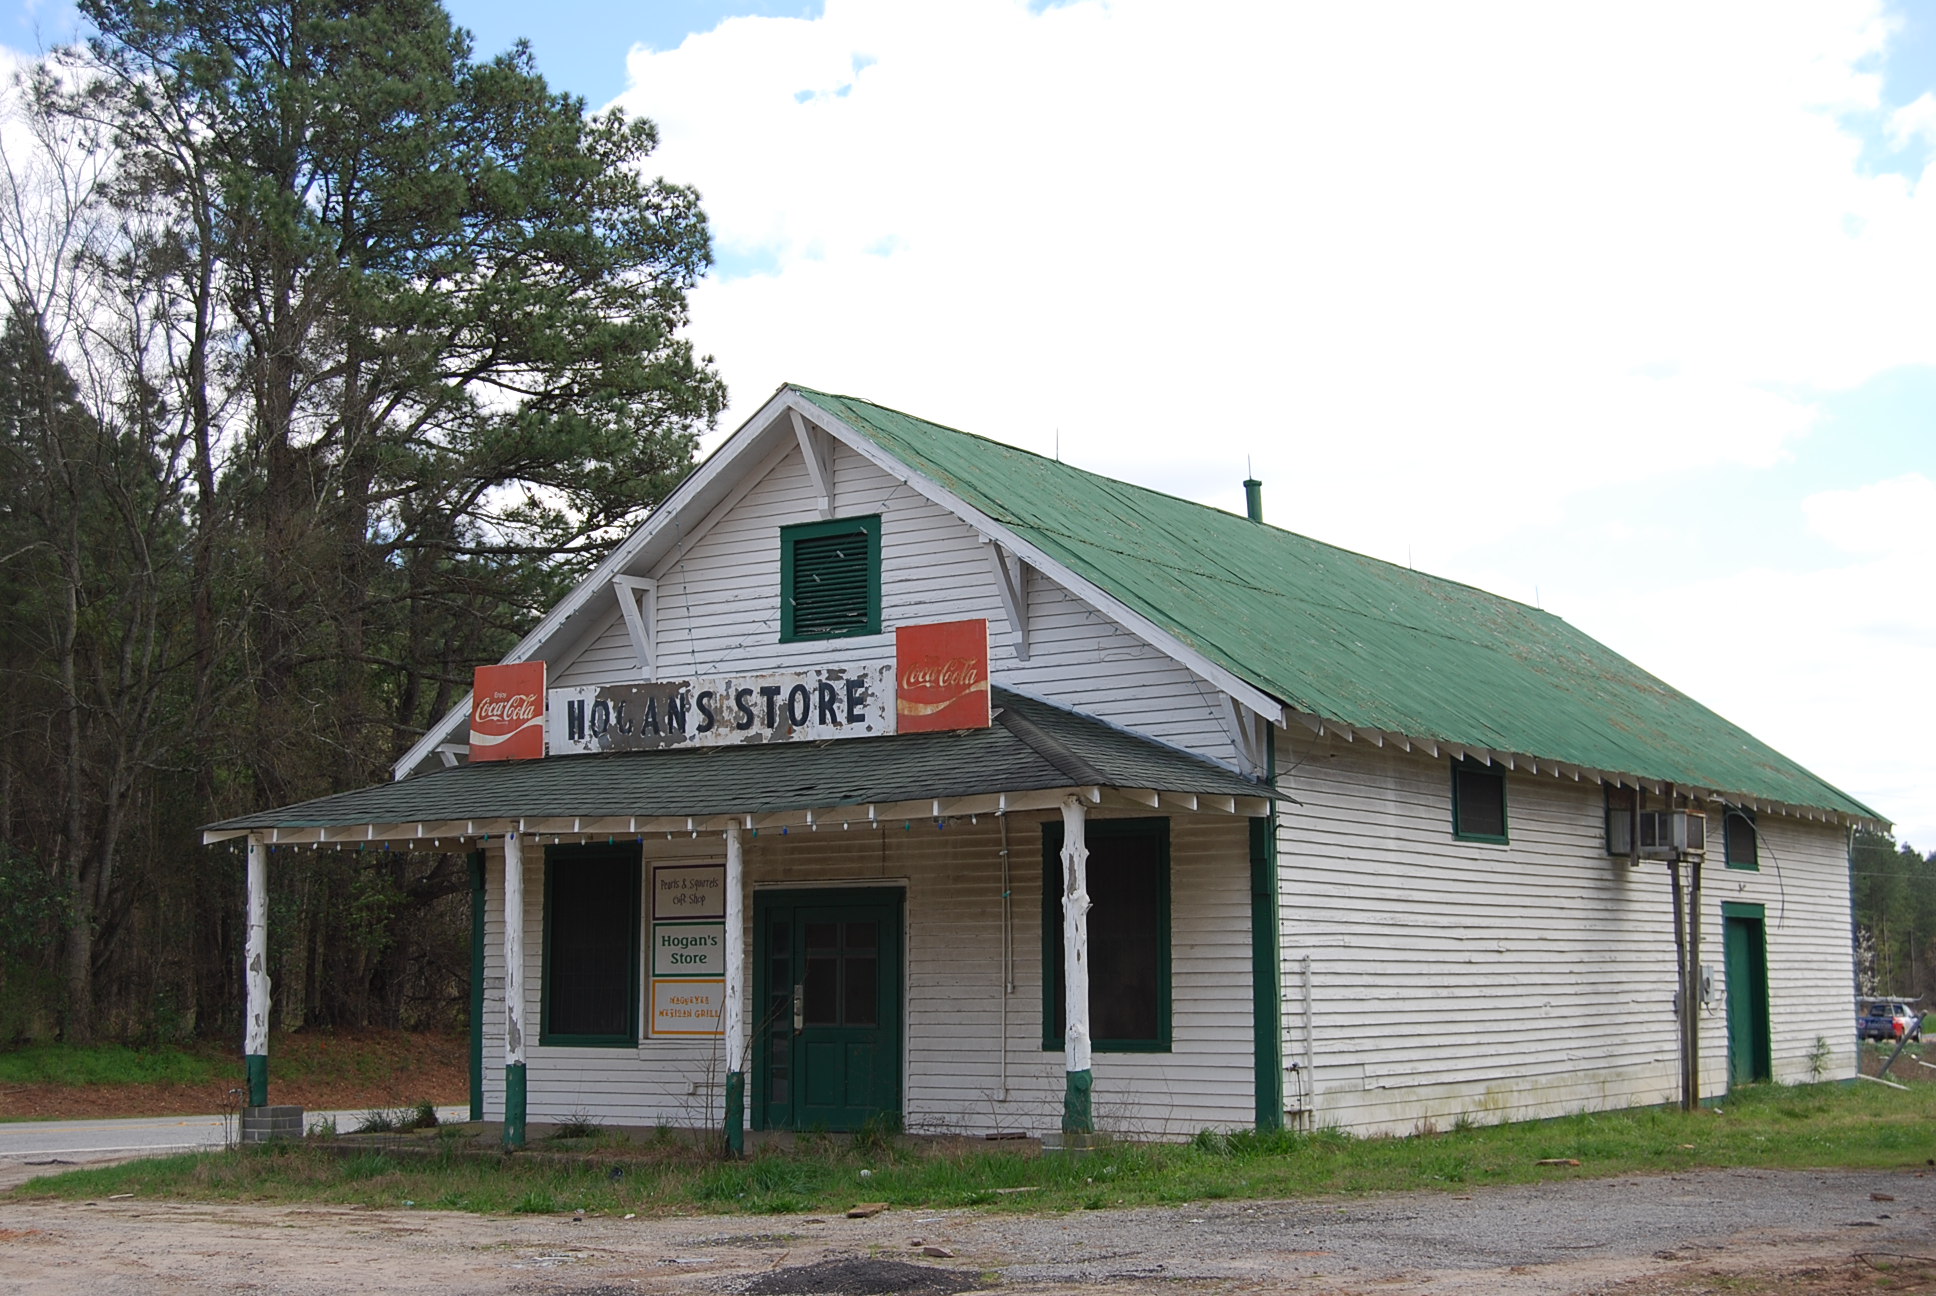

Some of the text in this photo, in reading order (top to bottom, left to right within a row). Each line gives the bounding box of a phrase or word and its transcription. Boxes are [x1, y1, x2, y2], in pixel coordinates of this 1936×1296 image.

[901, 656, 978, 690] Coca-Cola
[475, 694, 538, 723] Coca-Cola
[735, 679, 866, 731] STORE
[688, 893, 706, 907] Shop
[661, 934, 718, 949] Hogan's
[670, 952, 708, 965] Store
[694, 1008, 720, 1018] GRILL
